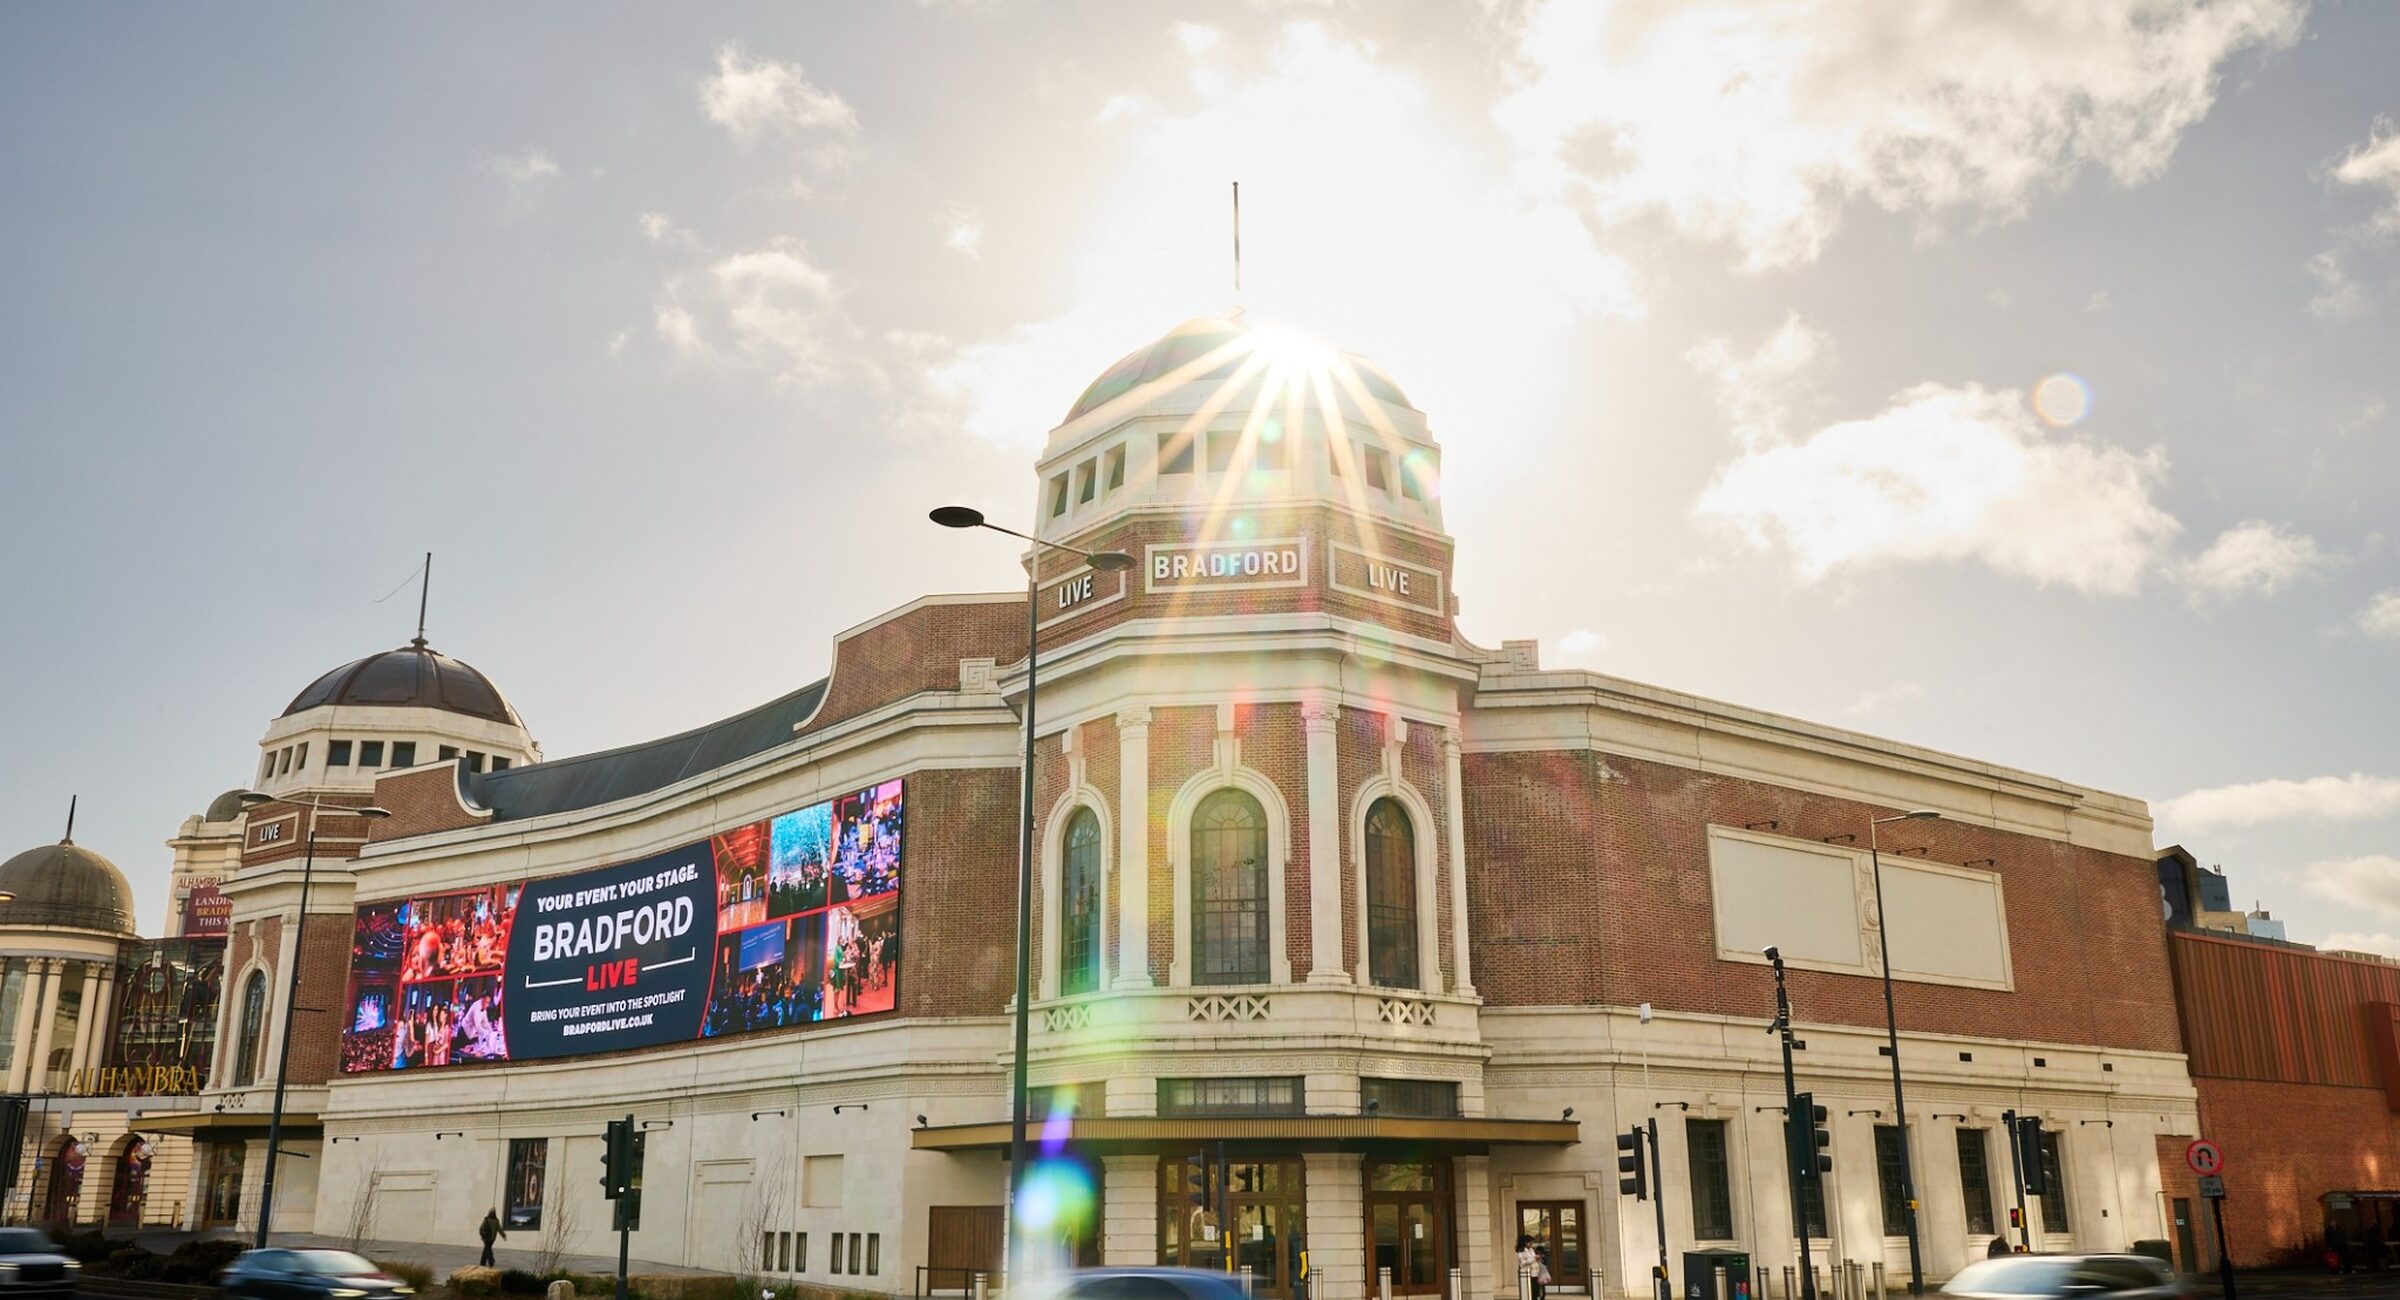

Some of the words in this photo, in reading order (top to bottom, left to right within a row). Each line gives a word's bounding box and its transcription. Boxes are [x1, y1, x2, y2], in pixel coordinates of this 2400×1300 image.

[1154, 550, 1298, 580] BRADFORD
[1369, 563, 1410, 596] LIVE
[1058, 574, 1094, 609] LIVE
[260, 823, 281, 842] LIVE
[177, 876, 222, 889] ALHAMBRA
[537, 893, 573, 913] YOUR
[575, 885, 617, 907] EVENT.
[619, 876, 654, 898] YOUR
[655, 863, 699, 890] STAGE.
[200, 917, 222, 926] THIS
[533, 896, 694, 962] BRADFORD
[586, 957, 639, 992] LIVE
[530, 1010, 557, 1022] BRING
[558, 1006, 581, 1020] YOUR
[581, 1003, 606, 1017] EVENT
[606, 1000, 627, 1013] INTO
[627, 997, 643, 1010] THE
[643, 989, 686, 1008] SPOTLIGHT
[563, 1013, 653, 1036] BRADFORDLIVE.CO.UK
[69, 1065, 201, 1094] ALHAMBRA
